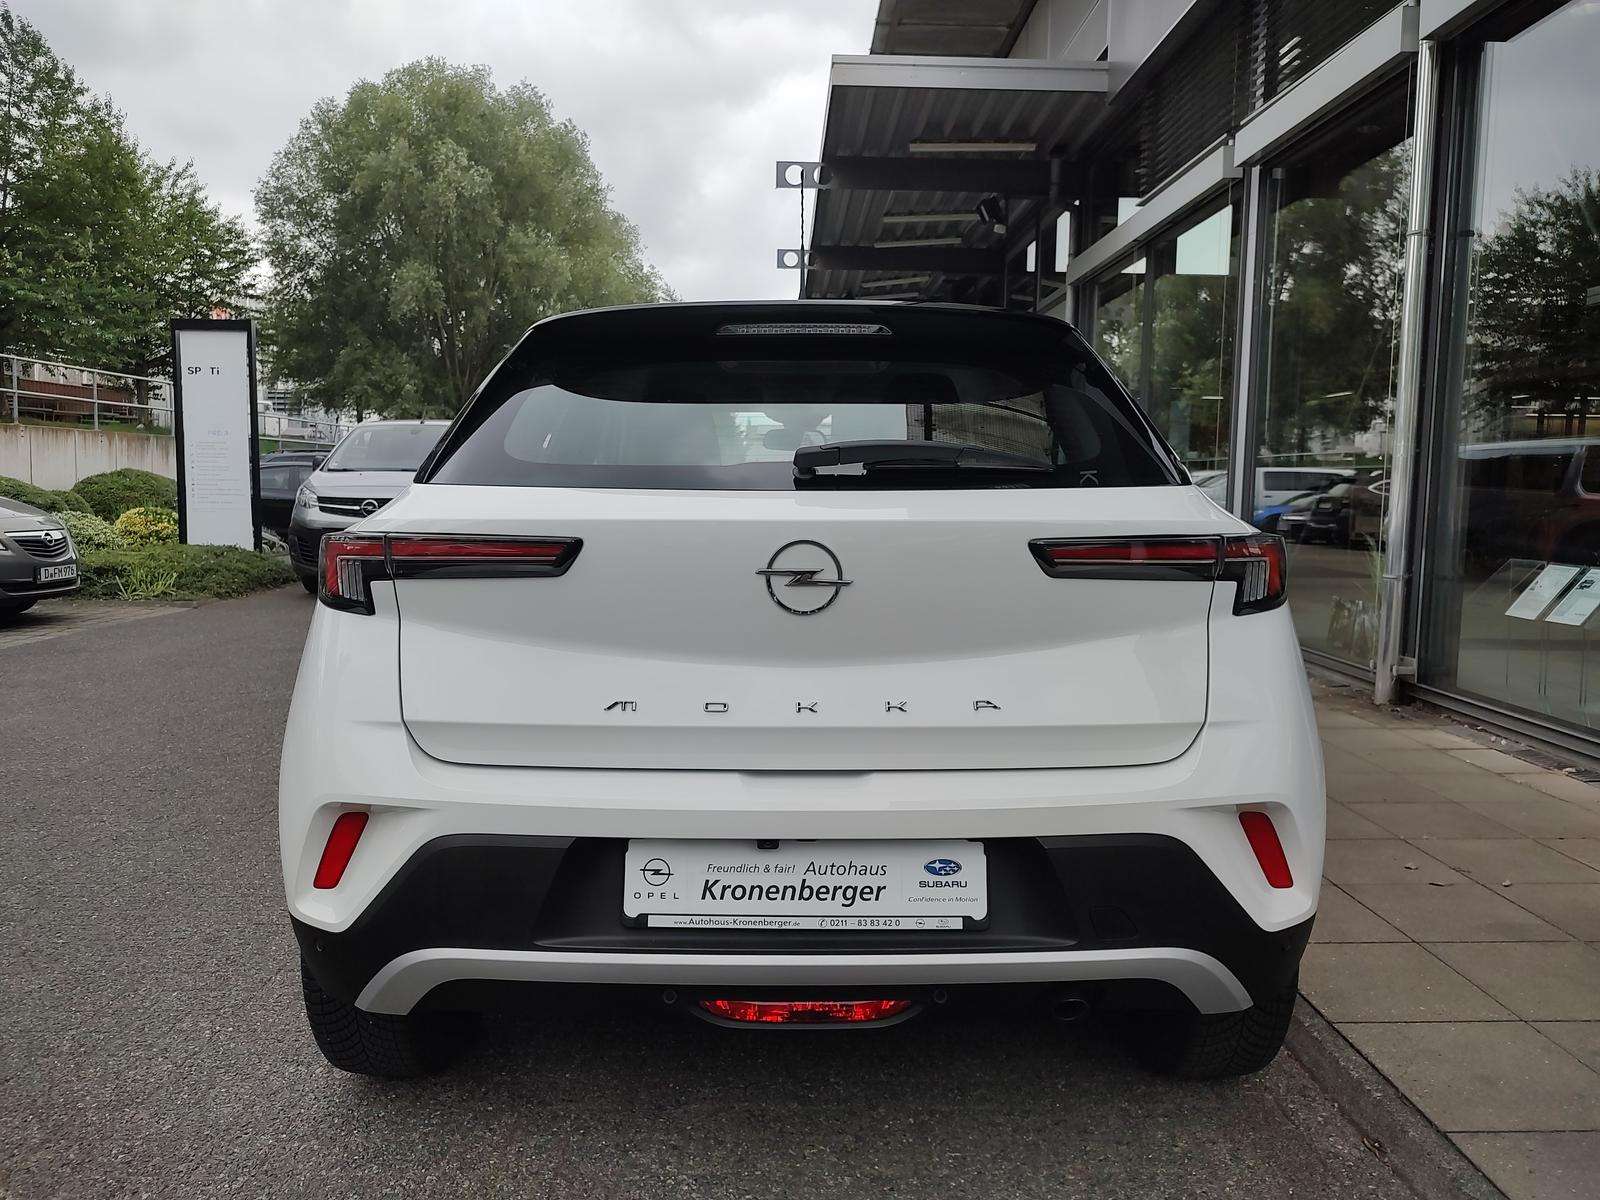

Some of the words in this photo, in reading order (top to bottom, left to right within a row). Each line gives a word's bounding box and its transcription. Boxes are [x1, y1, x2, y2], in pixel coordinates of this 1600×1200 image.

[44, 568, 50, 579] D
[604, 700, 1001, 714] MOKKA
[706, 863, 760, 874] Freundlich
[763, 864, 771, 874] &
[773, 863, 796, 875] fair!
[804, 860, 887, 876] Autohaus
[919, 880, 968, 888] SUBARU
[633, 891, 680, 900] OPEL
[701, 879, 886, 907] Kronenberger
[673, 917, 801, 928] www.Autohaus-Kronenberger.de
[829, 918, 848, 927] 0211
[857, 918, 868, 927] 83
[869, 918, 881, 928] 83
[883, 918, 893, 928] 42
[894, 918, 901, 928] 0
